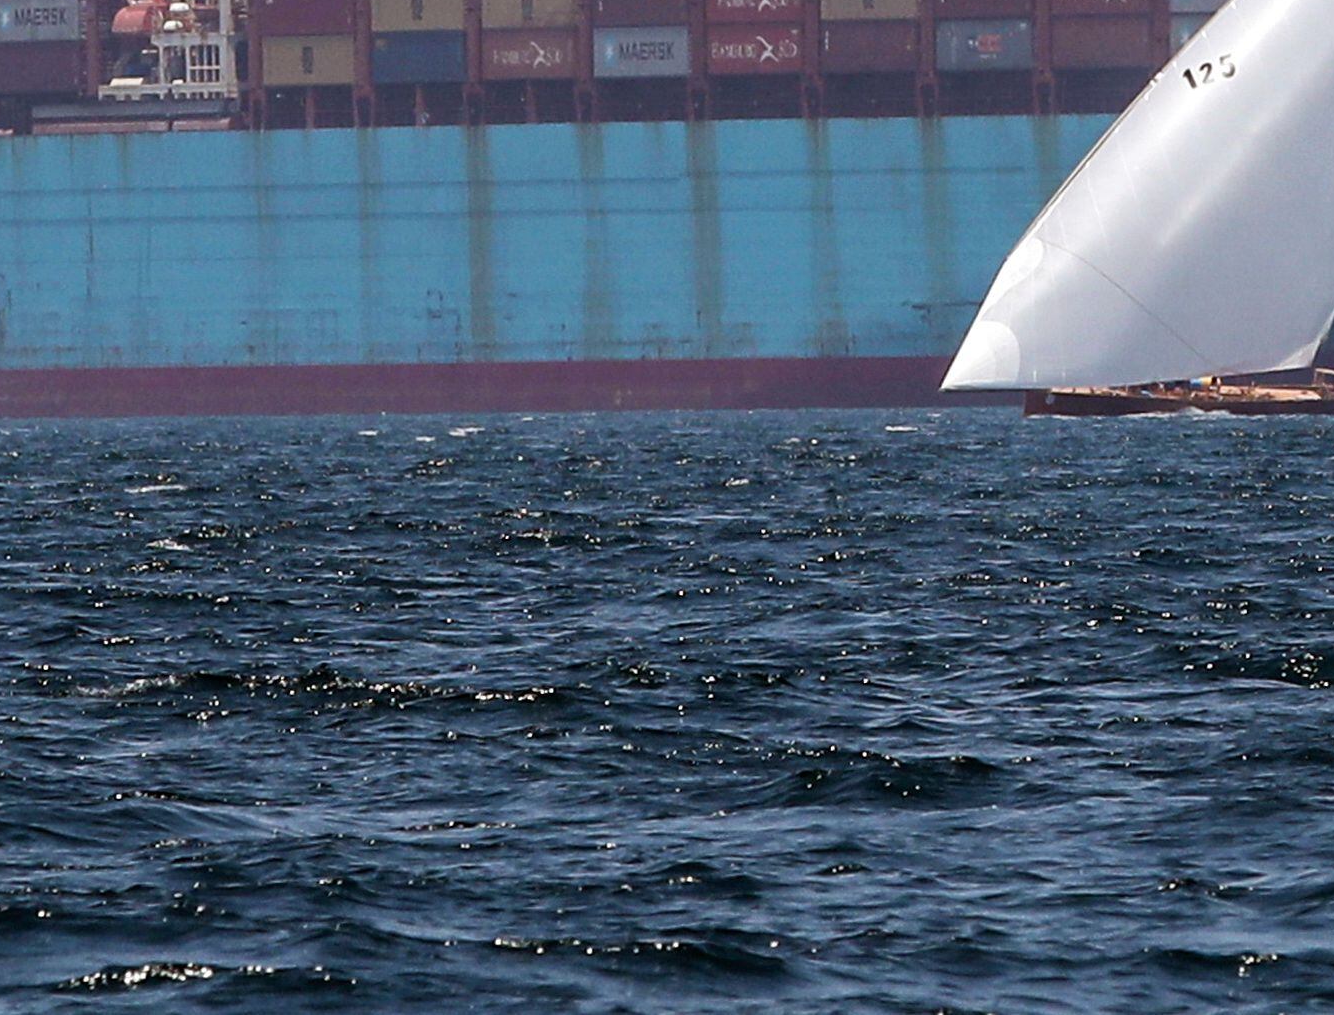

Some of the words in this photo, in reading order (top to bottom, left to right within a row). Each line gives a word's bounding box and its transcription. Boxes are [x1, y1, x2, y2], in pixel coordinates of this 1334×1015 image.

[14, 7, 67, 26] MAERSK
[619, 42, 674, 61] MAERSK
[1182, 54, 1236, 89] 125
